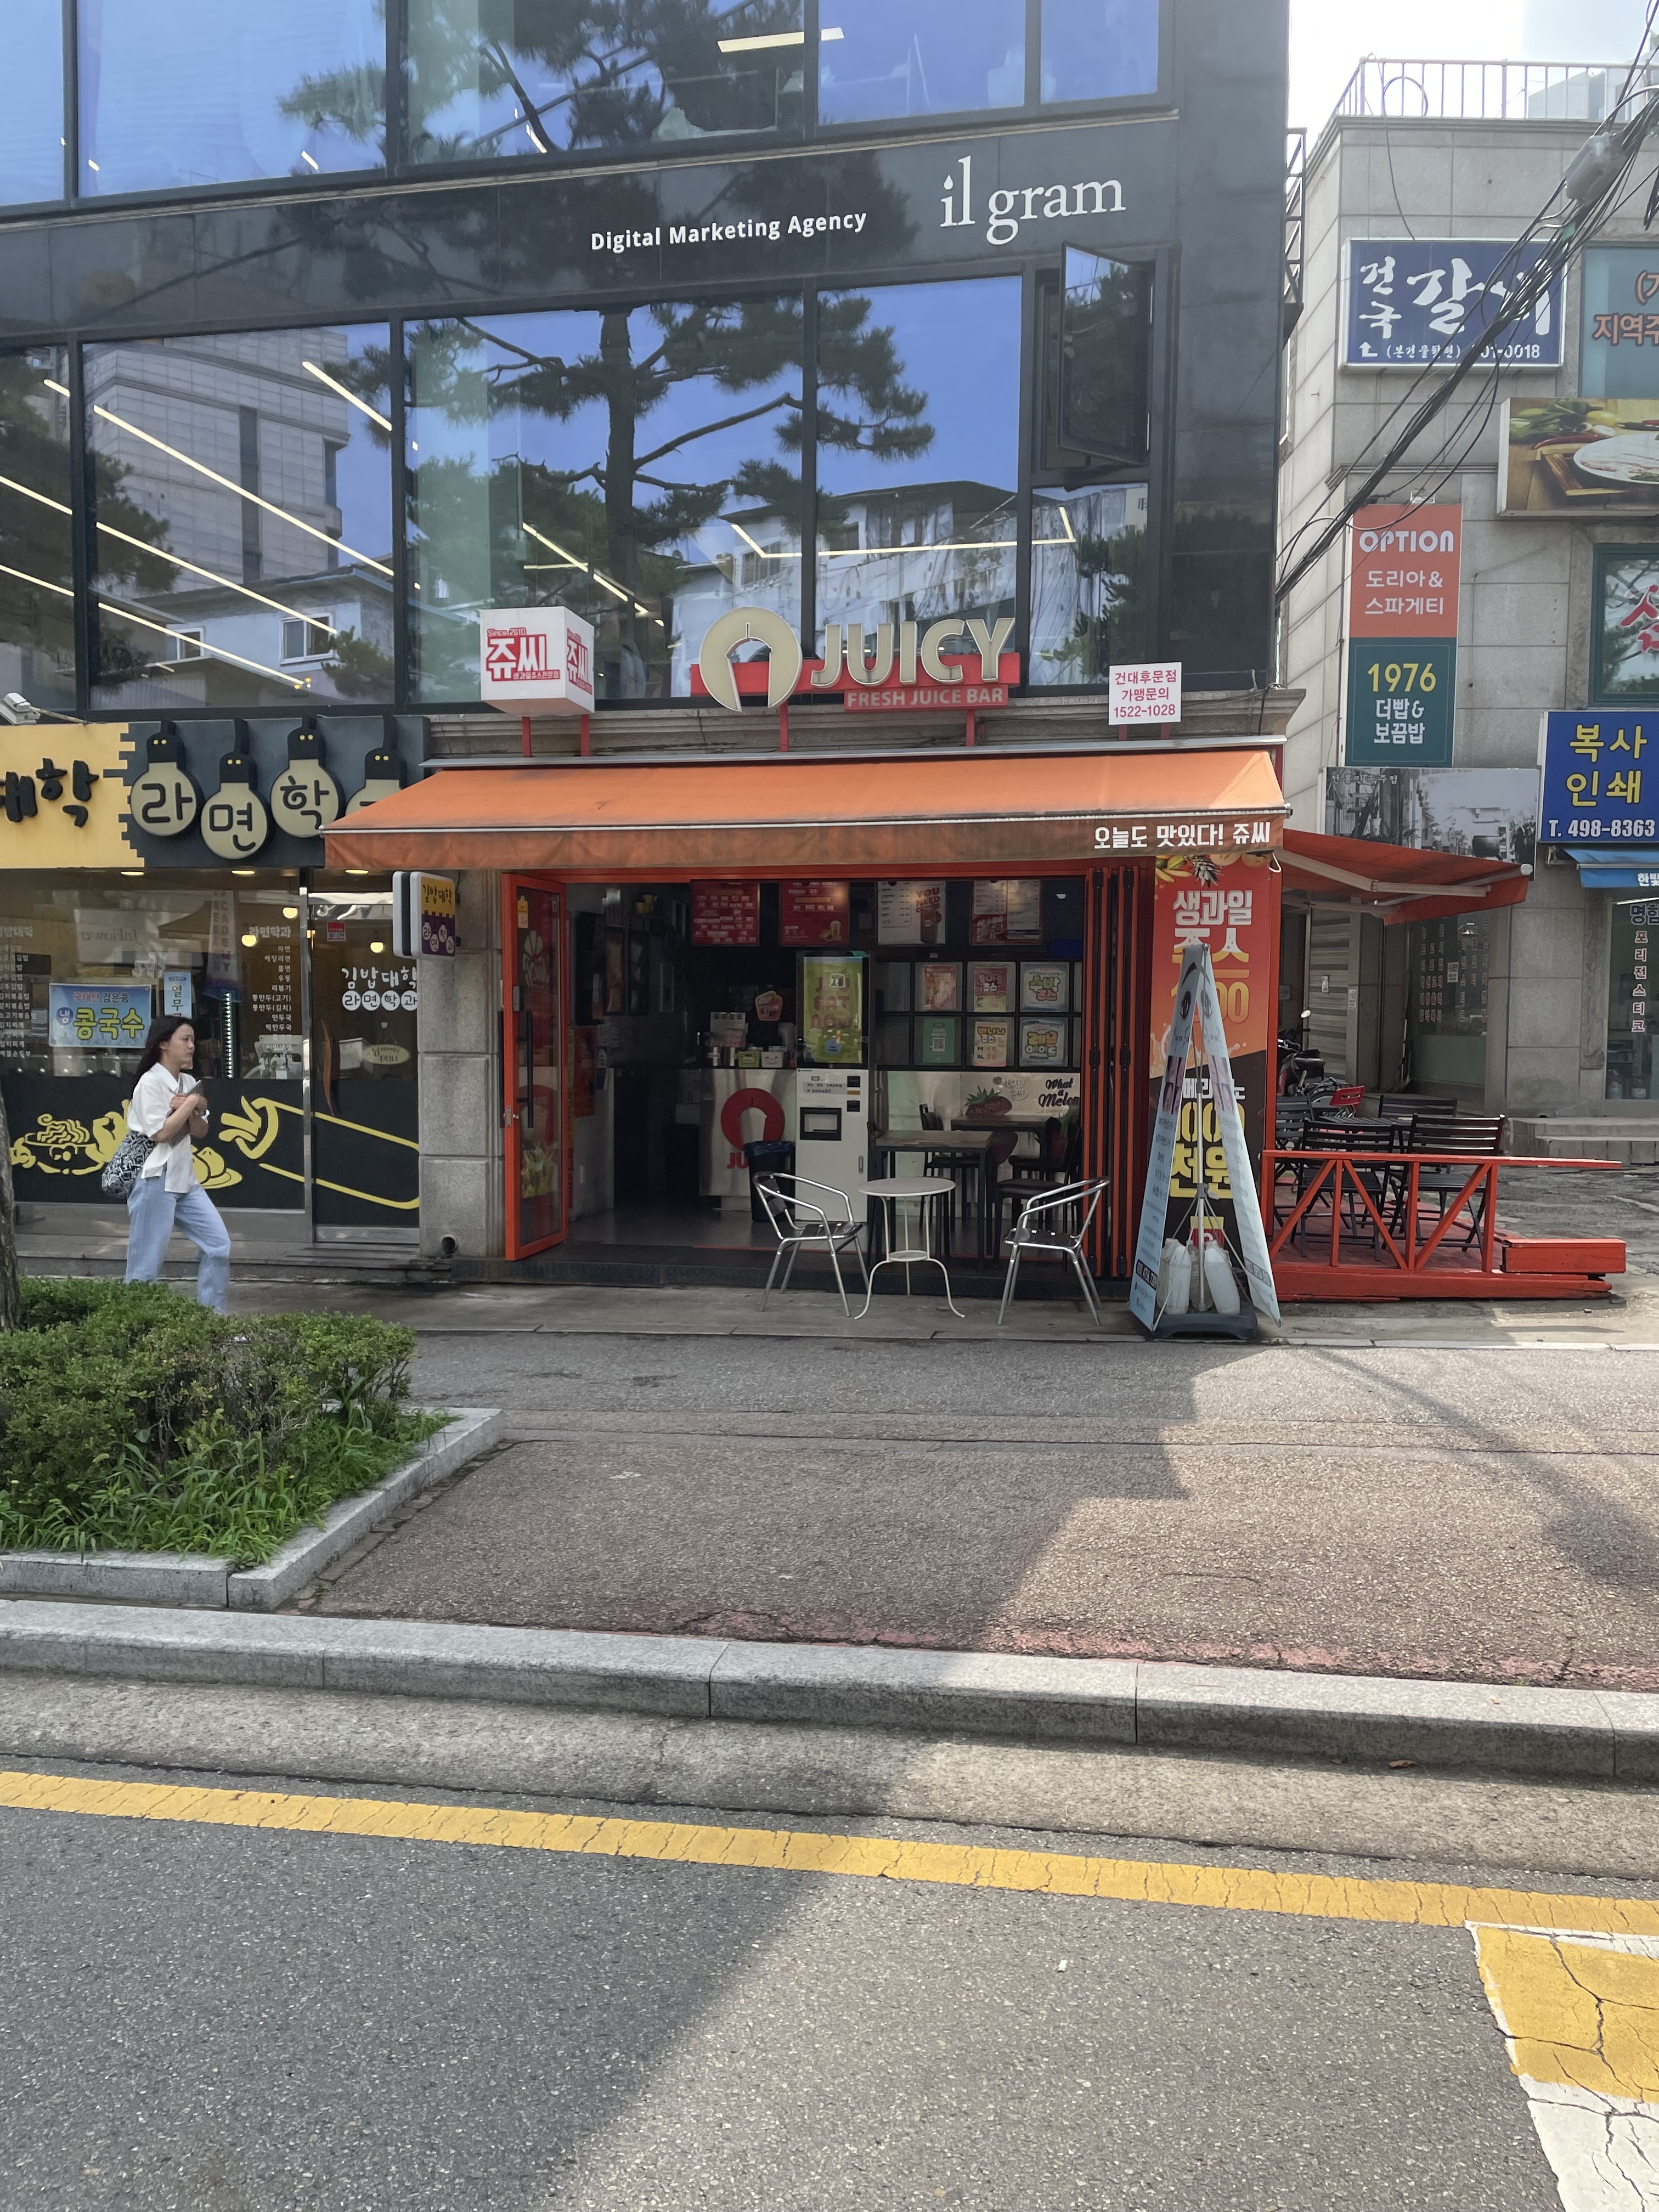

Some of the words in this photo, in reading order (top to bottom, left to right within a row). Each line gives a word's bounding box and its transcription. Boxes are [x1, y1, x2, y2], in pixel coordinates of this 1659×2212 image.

[940, 155, 975, 228] il
[986, 178, 1126, 245] gram
[590, 226, 661, 253] Digital
[669, 216, 781, 245] Marketing
[787, 211, 867, 236] Agency
[1359, 529, 1454, 553] OPTION
[1365, 570, 1443, 588] 도리아&
[1364, 597, 1443, 615] 스파게티
[509, 627, 527, 636] 2010
[488, 636, 546, 680] 쥬씨
[811, 617, 1015, 687] JUICY
[1114, 669, 1177, 686] 건대후문점
[1367, 663, 1437, 692] 1976
[847, 690, 905, 708] FRESH
[910, 689, 963, 706] JUICE
[967, 687, 1004, 703] BAR
[1121, 686, 1170, 702] 가맹문의
[1113, 704, 1176, 718] 1522-1028
[1570, 724, 1648, 763] 복사
[1566, 770, 1643, 807] 인쇄
[1094, 825, 1148, 849] 오늘도
[1156, 823, 1224, 848] 맛있다!
[1232, 821, 1271, 844] 쥬씨
[1568, 819, 1656, 838] 498-8363
[1172, 889, 1253, 926] 생과일
[102, 991, 129, 1003] 검은콩
[72, 1007, 145, 1040] 콩국수
